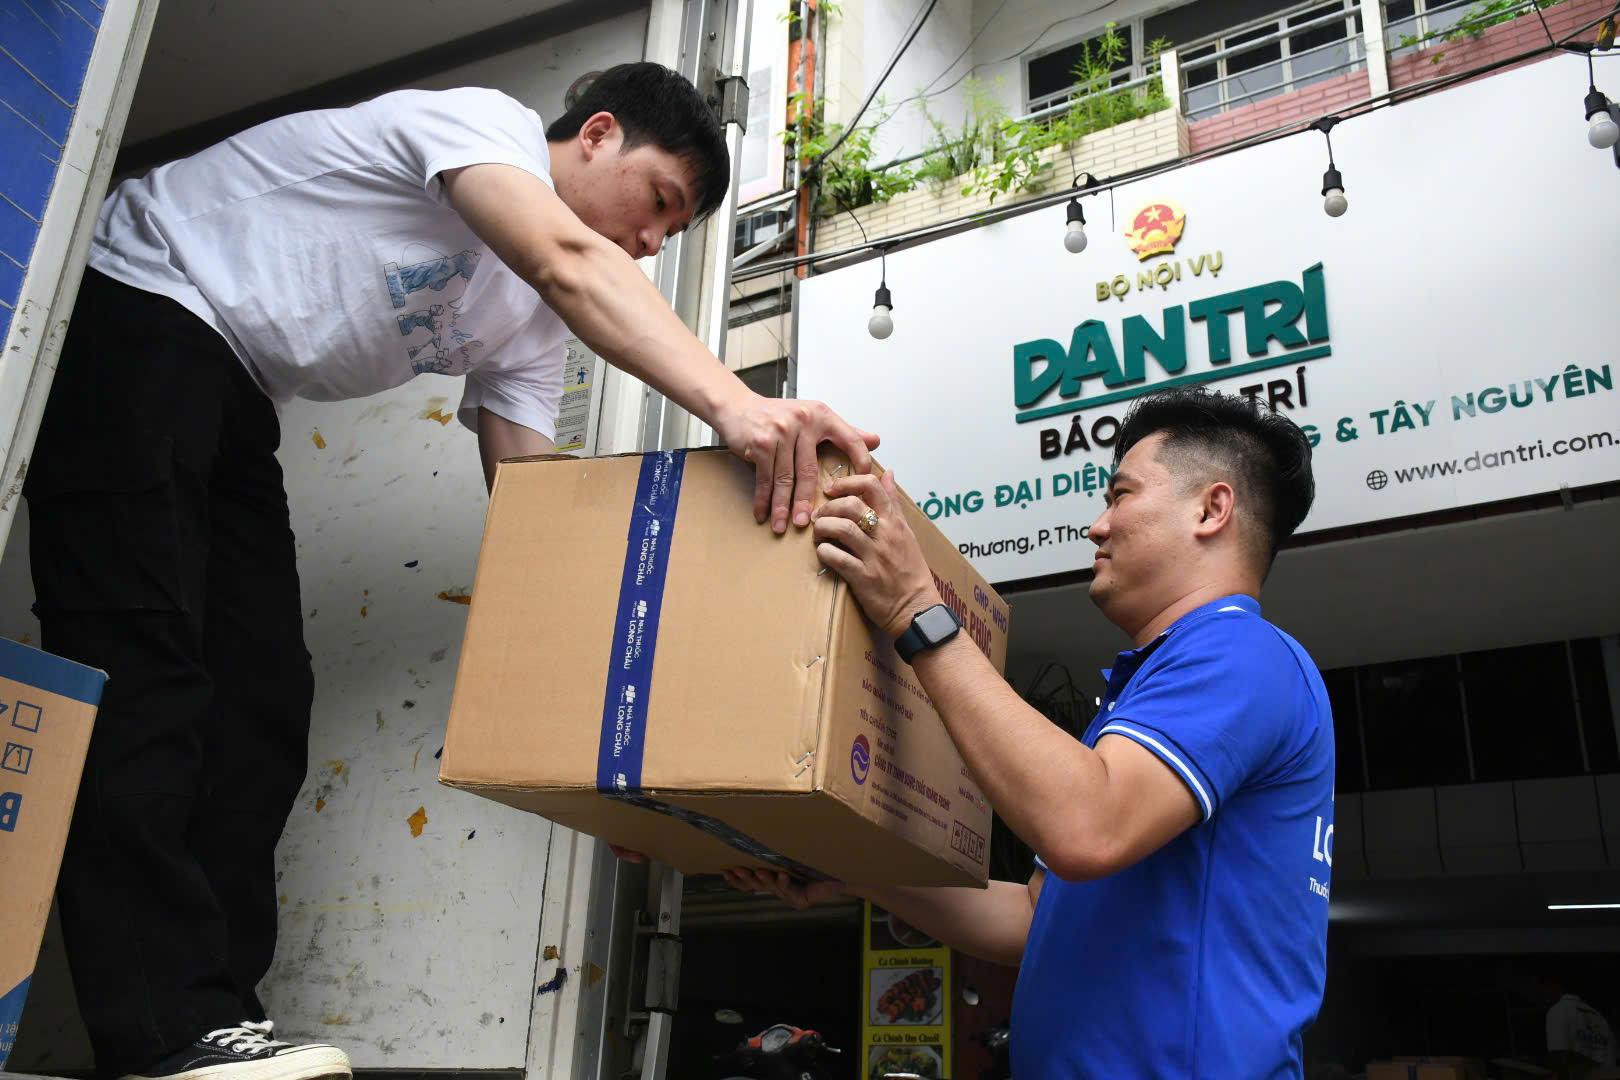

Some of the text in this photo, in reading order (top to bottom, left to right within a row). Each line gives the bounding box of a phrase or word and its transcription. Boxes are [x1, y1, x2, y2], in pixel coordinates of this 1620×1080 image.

[1095, 250, 1223, 302] BỘ NỘI VỤ
[1040, 366, 1308, 461] BÁO TRÍ
[1335, 417, 1359, 443] &
[1369, 400, 1436, 436] TÂY
[1450, 364, 1614, 422] NGUYÊN
[653, 460, 663, 482] LONG
[916, 461, 1118, 521] ÒNG ĐẠI DIỆN
[640, 538, 650, 562] LONG
[635, 562, 646, 586] CHÂU
[974, 585, 989, 610] GMP
[993, 605, 1007, 635] WHO
[627, 620, 637, 644] LONG
[623, 645, 633, 670] CHÂU
[616, 705, 626, 731] LONG
[613, 732, 623, 757] CHÂU
